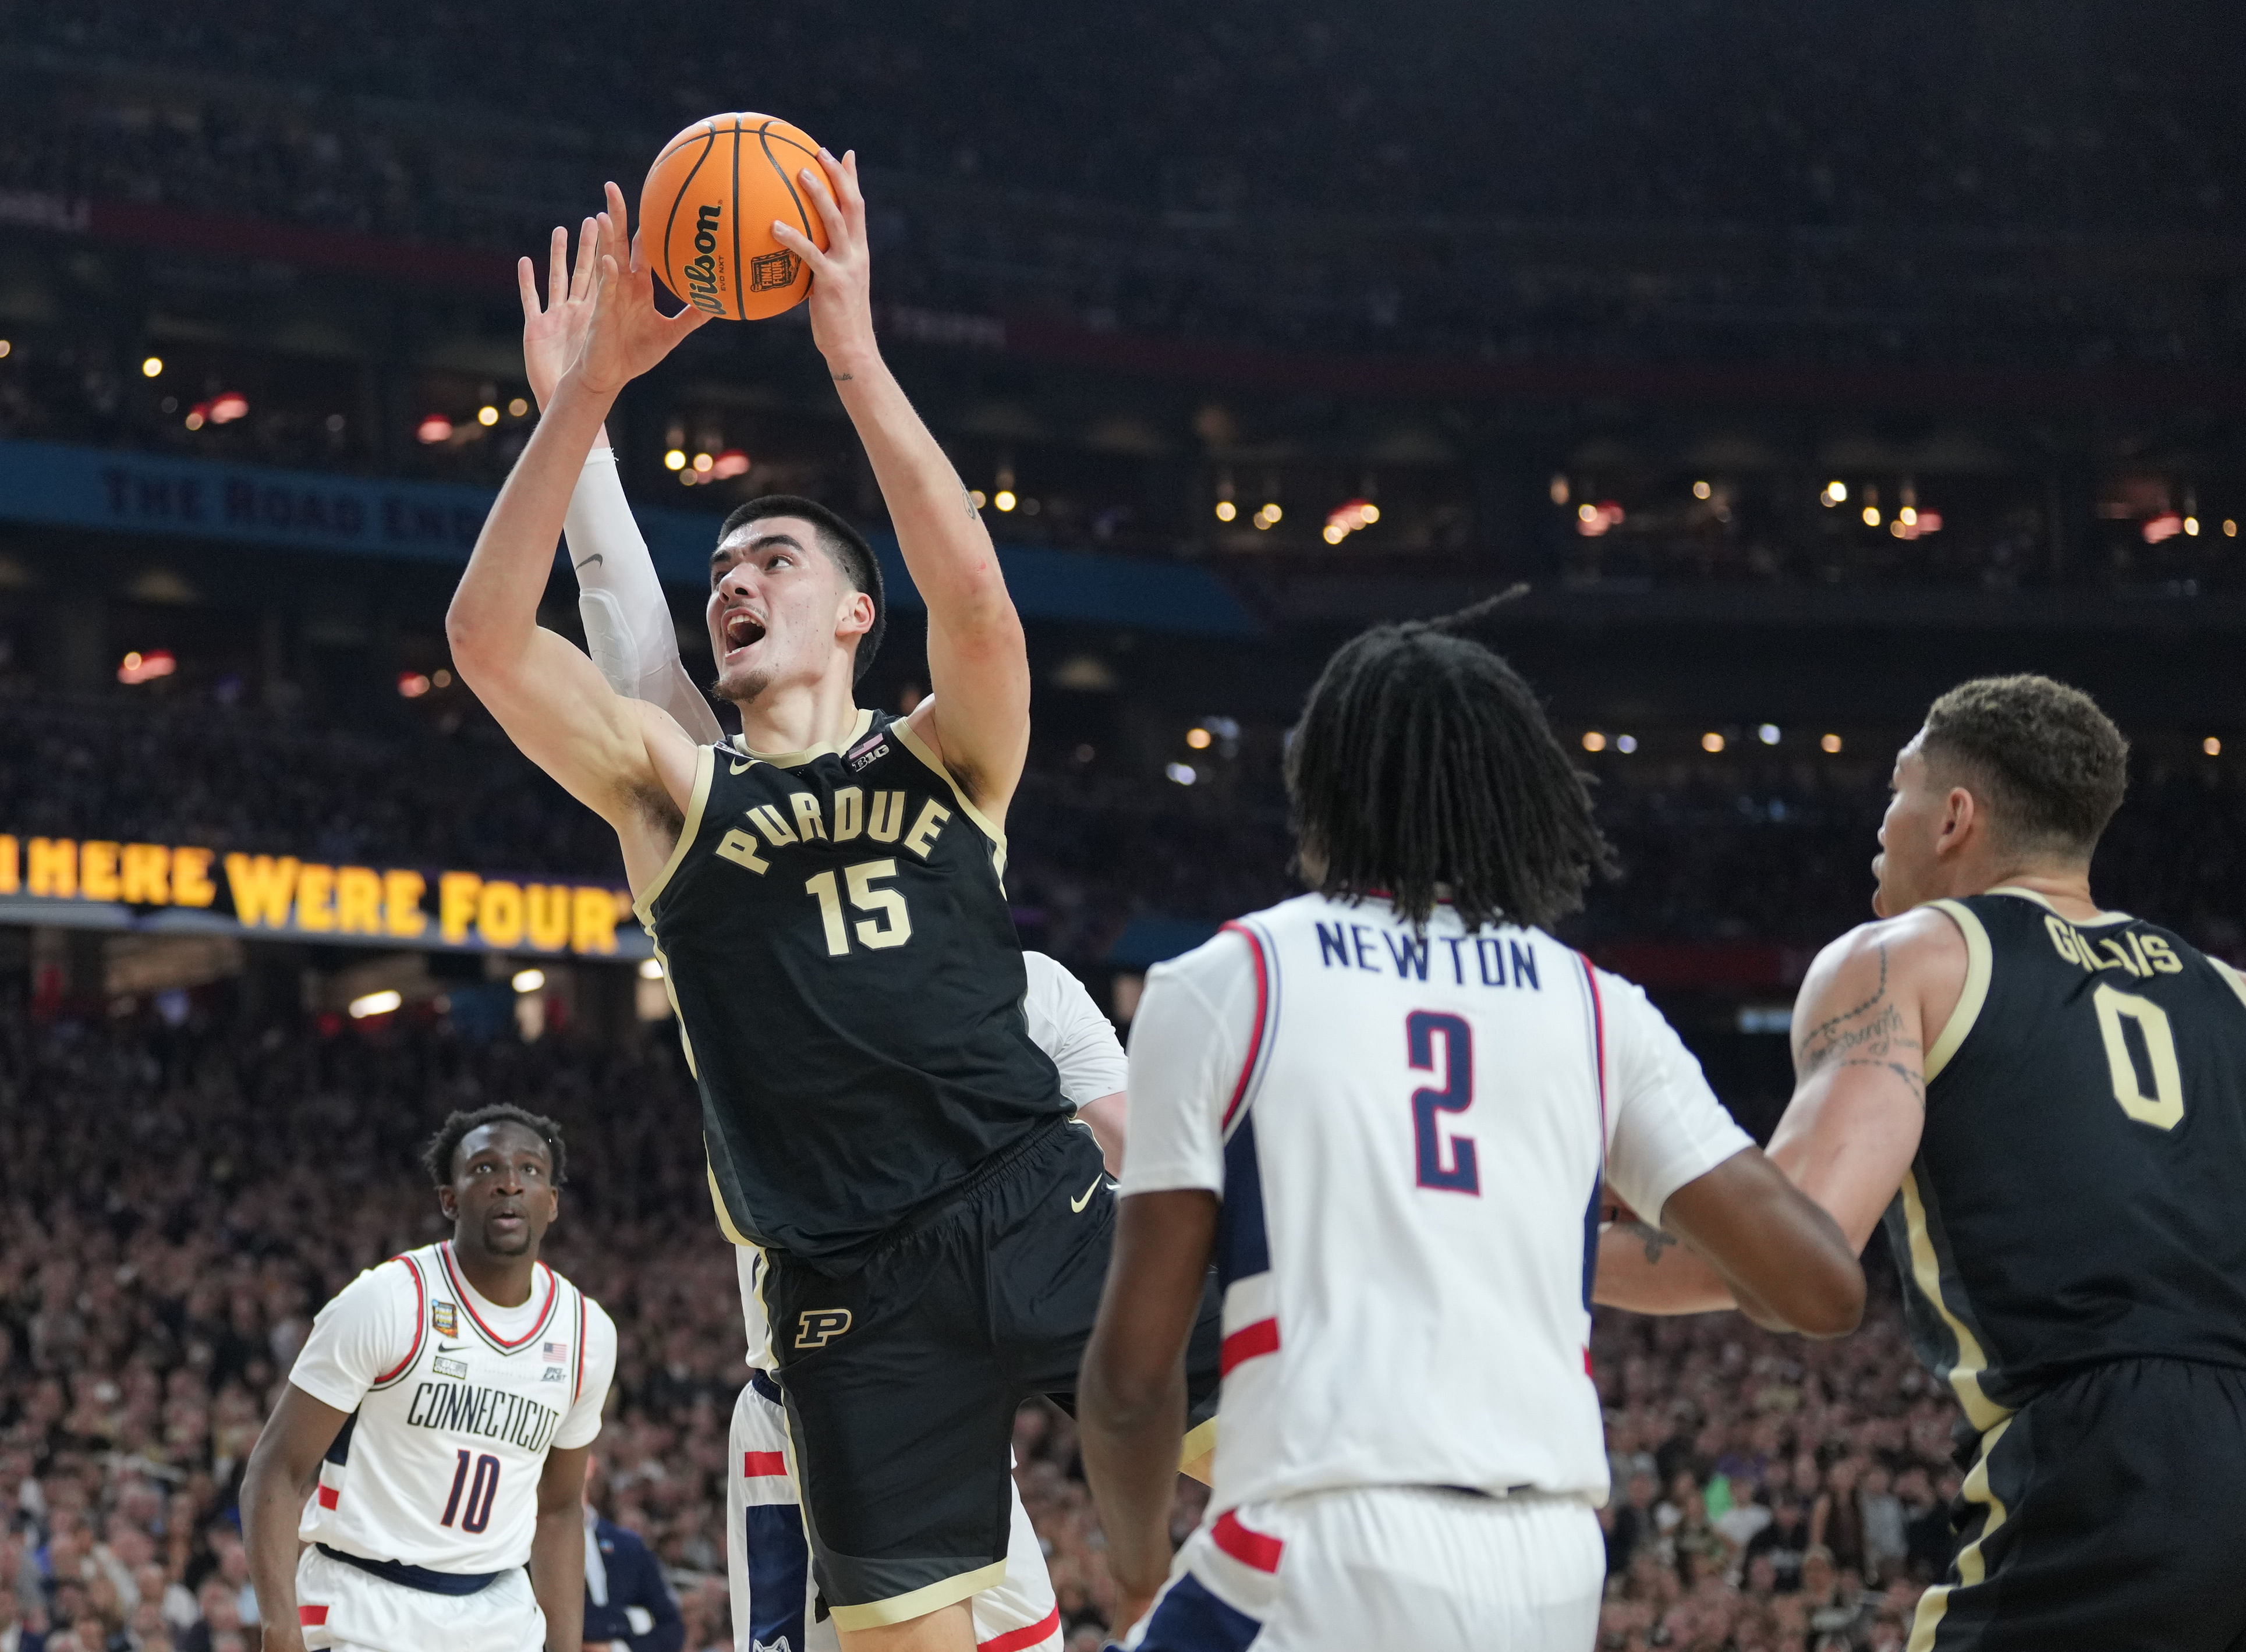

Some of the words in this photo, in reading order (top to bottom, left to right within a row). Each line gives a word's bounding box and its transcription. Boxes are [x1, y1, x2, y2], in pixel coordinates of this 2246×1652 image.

[683, 205, 727, 315] Wilson
[761, 263, 773, 286] FINAL
[772, 260, 784, 285] FOUR
[714, 785, 954, 877] PURDUE
[224, 852, 427, 938] WERE
[805, 856, 913, 957] 15
[1315, 921, 1542, 991] NEWTON
[2093, 982, 2184, 1131] 0
[1405, 1009, 1482, 1197] 2
[795, 1309, 852, 1349] P
[407, 1382, 559, 1454] CONNECTICUT
[440, 1448, 501, 1534] 10
